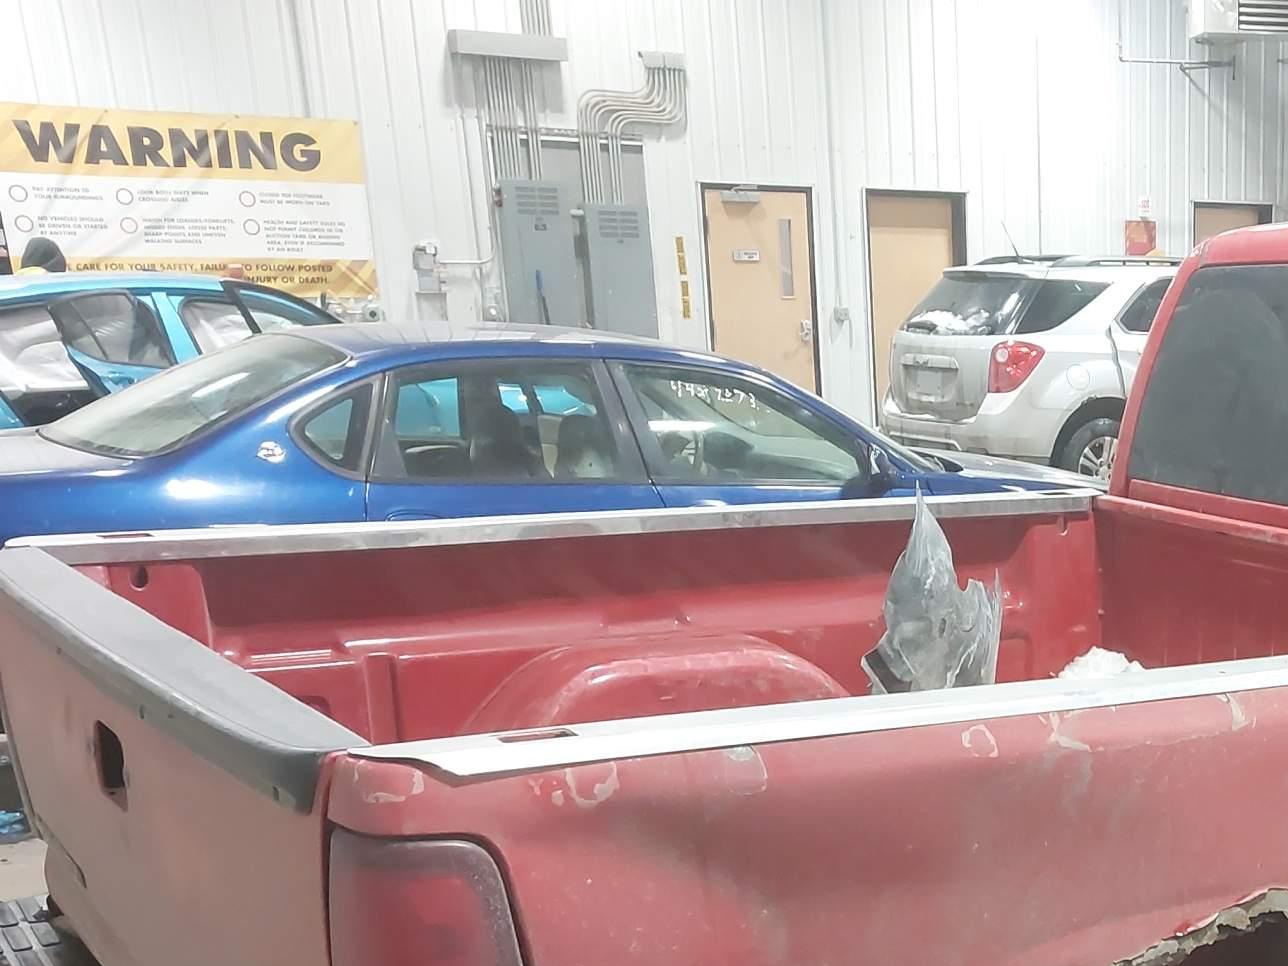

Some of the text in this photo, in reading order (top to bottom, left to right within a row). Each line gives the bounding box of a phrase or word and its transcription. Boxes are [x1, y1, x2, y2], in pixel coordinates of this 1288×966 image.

[13, 119, 320, 172] WARNING
[76, 263, 101, 271] CARE
[105, 263, 124, 271] FOR
[128, 263, 156, 271] YOUR
[256, 263, 295, 272] FOLLOW
[298, 264, 333, 273] POSTED
[281, 276, 294, 284] OR
